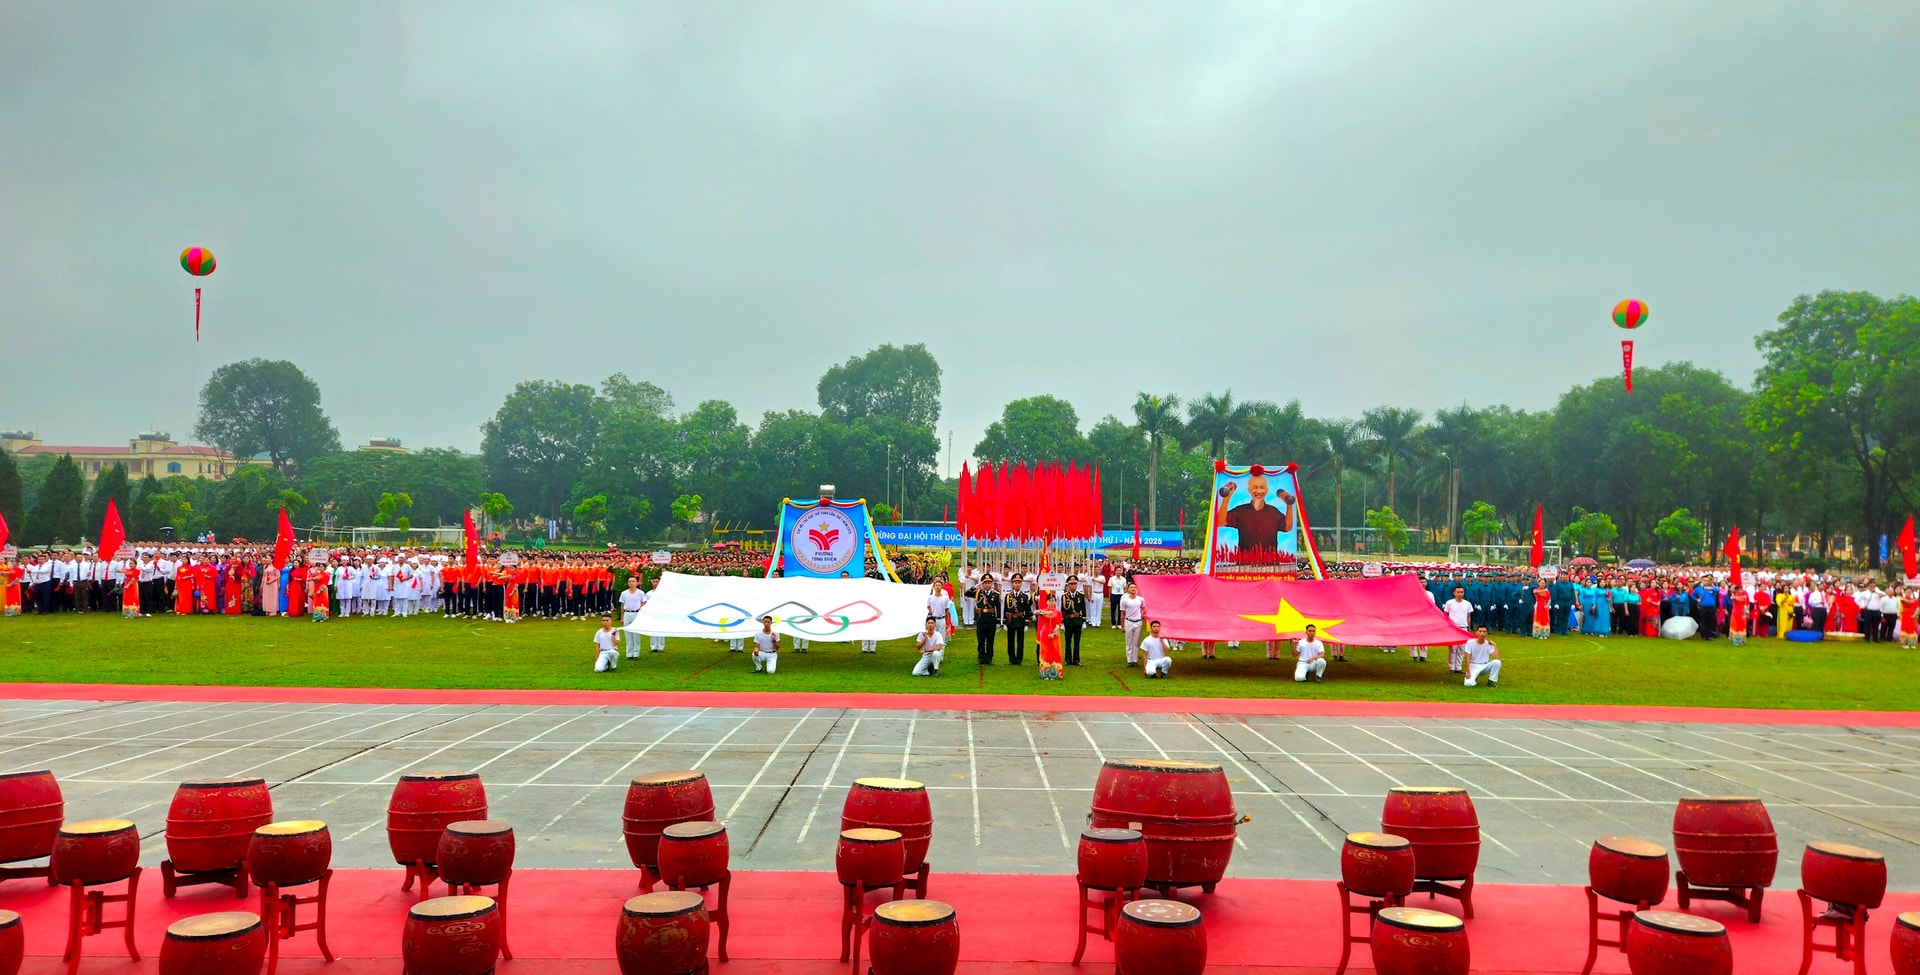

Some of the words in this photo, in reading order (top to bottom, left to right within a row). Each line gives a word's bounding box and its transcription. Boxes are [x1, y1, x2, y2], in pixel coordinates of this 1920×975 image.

[898, 532, 911, 541] ĐẠI
[914, 531, 927, 542] HỘI
[930, 530, 943, 540] THỂ
[945, 533, 961, 542] DỤC
